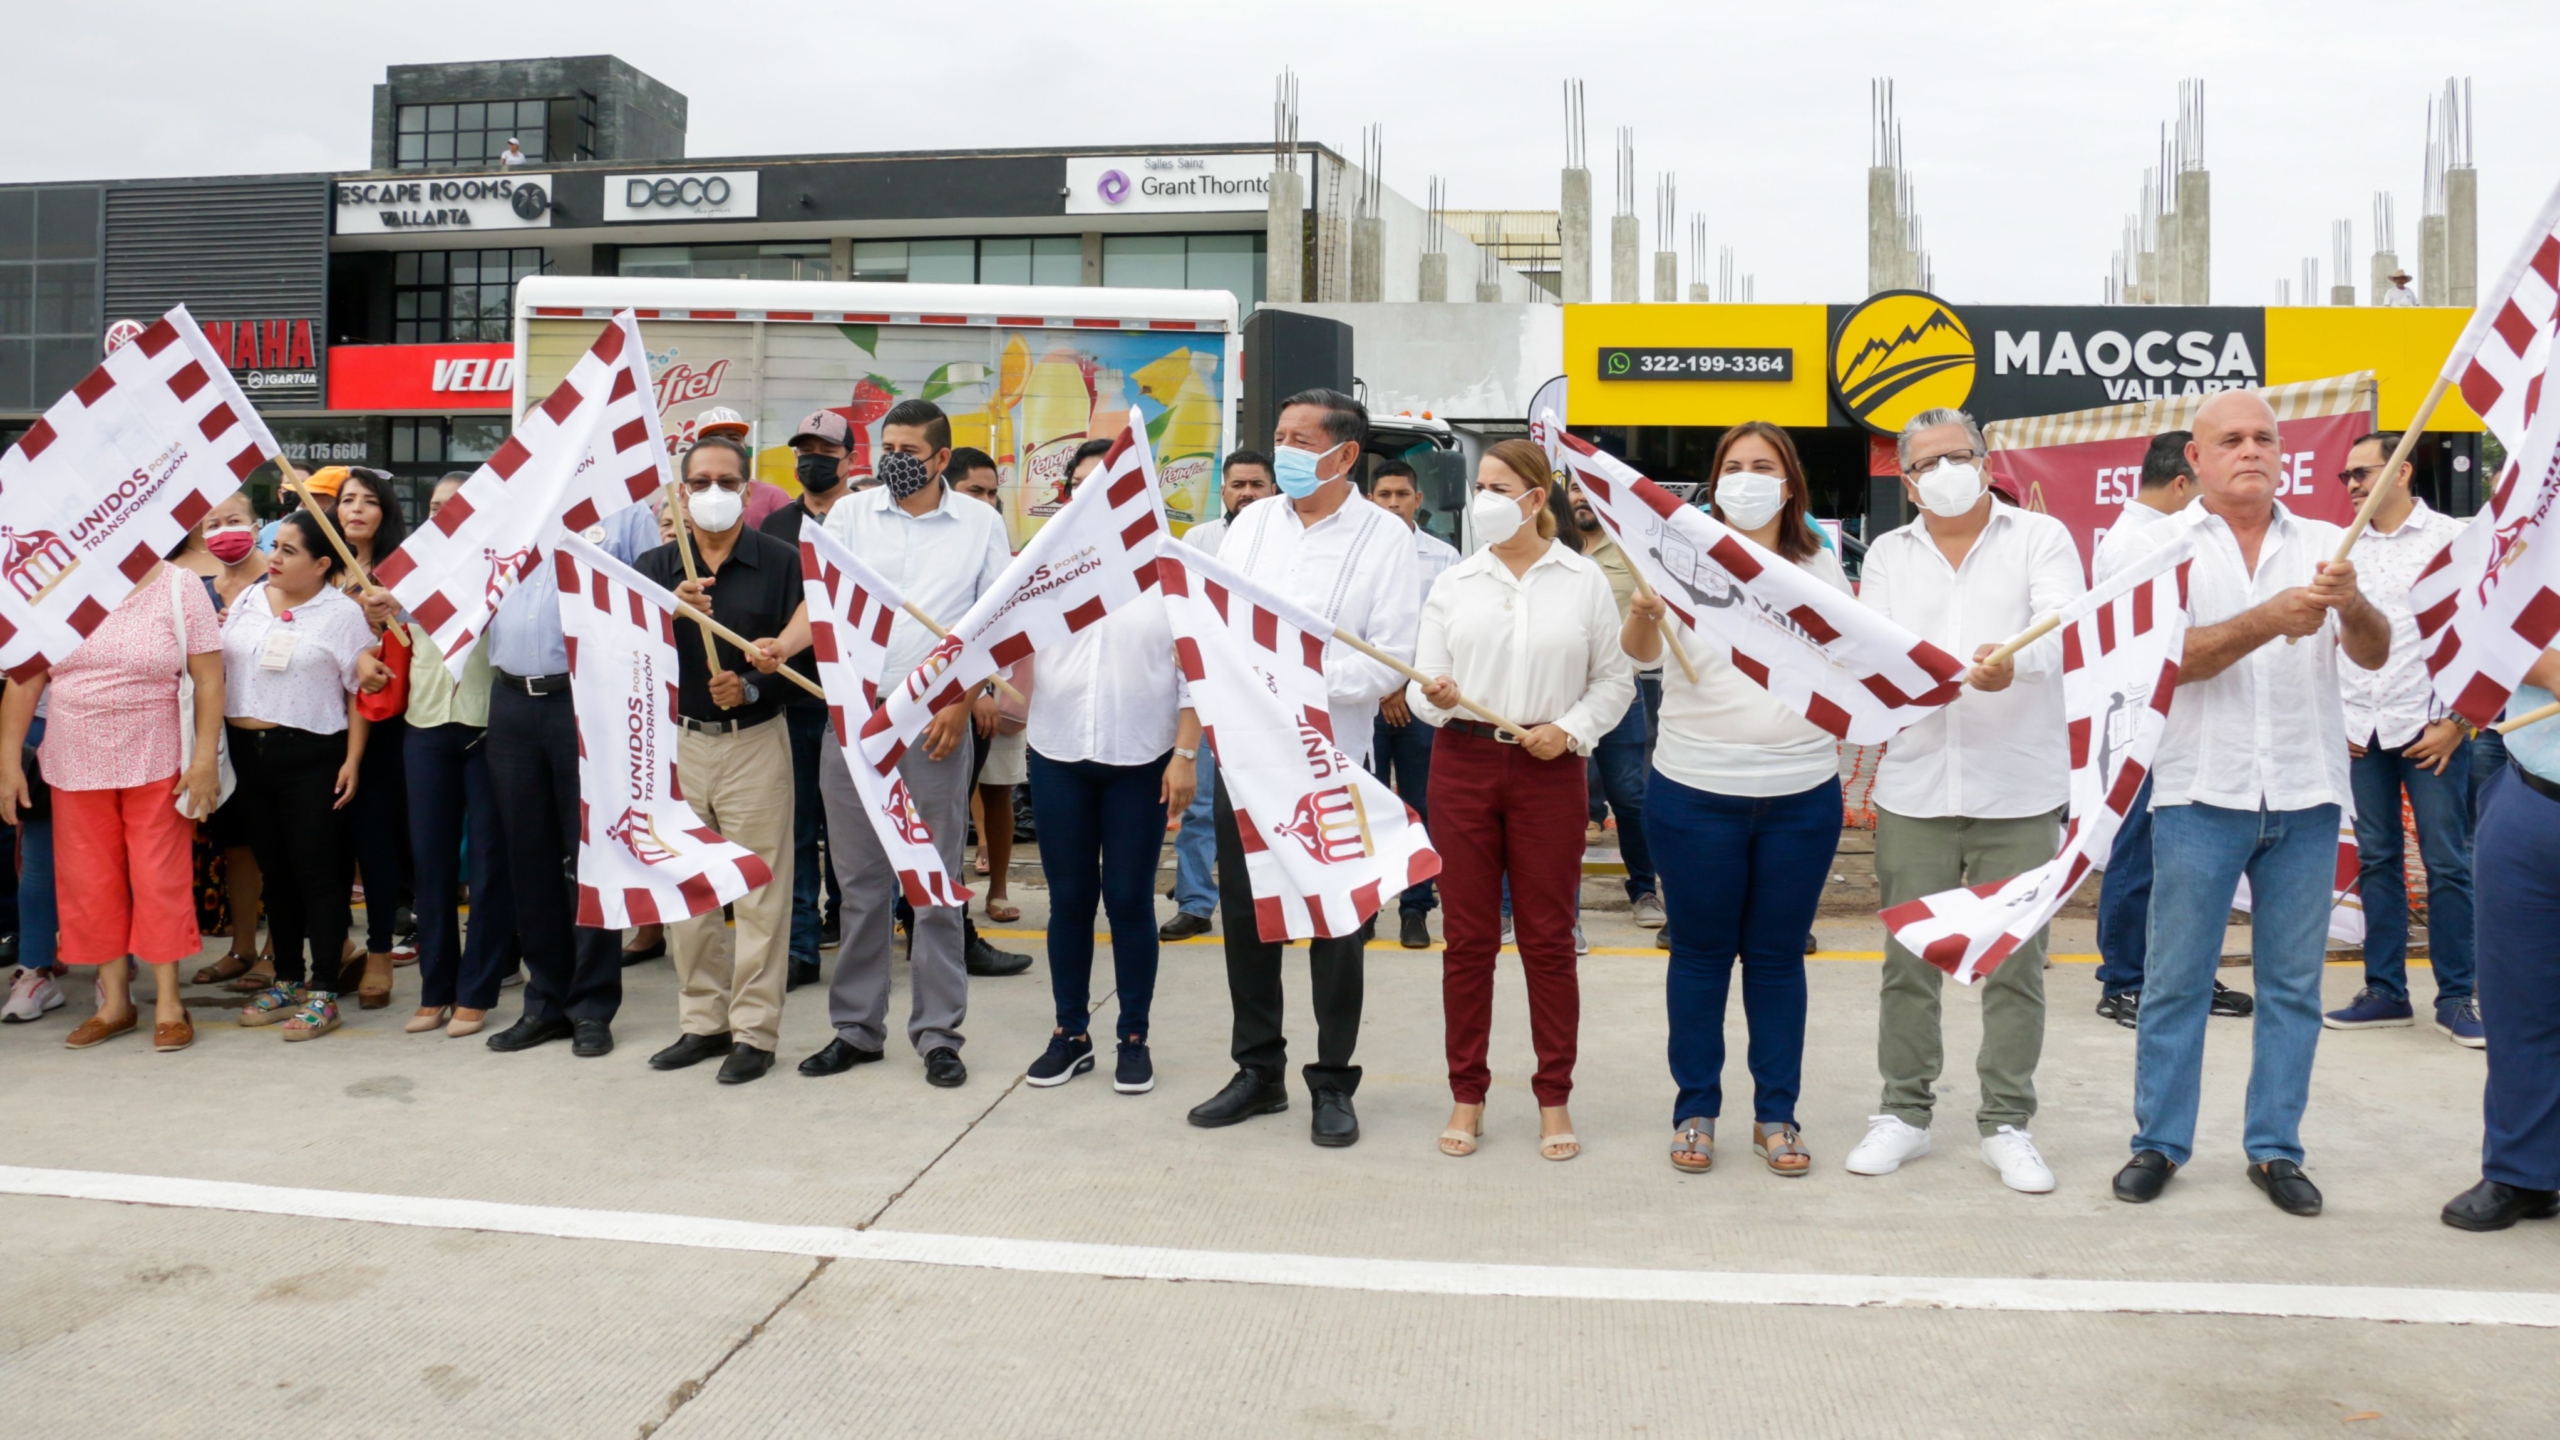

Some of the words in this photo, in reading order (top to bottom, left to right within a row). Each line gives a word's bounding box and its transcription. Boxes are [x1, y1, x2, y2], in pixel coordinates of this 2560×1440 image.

[1144, 158, 1174, 170] Salles
[1177, 157, 1204, 169] Sainz
[338, 183, 421, 205] ESCAPE
[429, 179, 513, 201] ROOMS
[1141, 177, 1196, 196] Grant
[380, 208, 471, 226] VALLARTA
[204, 320, 316, 369] MAHA
[1994, 330, 2258, 377] MAOCSA
[1640, 355, 1785, 372] 322-199-3364
[265, 373, 317, 385] IGARTUA
[282, 443, 307, 459] 322
[309, 443, 330, 459] 175
[332, 442, 367, 459] 6604
[69, 467, 150, 543] UNIDOS
[148, 452, 170, 473] POR
[169, 440, 182, 455] LA
[2095, 465, 2143, 505] EST
[83, 450, 189, 552] TRANSFORMACIÓN
[1053, 554, 1079, 571] POR
[1080, 545, 1097, 557] LA
[632, 650, 640, 665] LA
[632, 667, 640, 693] POR
[644, 653, 655, 802] TRANSFORMACIÓN
[627, 696, 644, 801] UNIDOS
